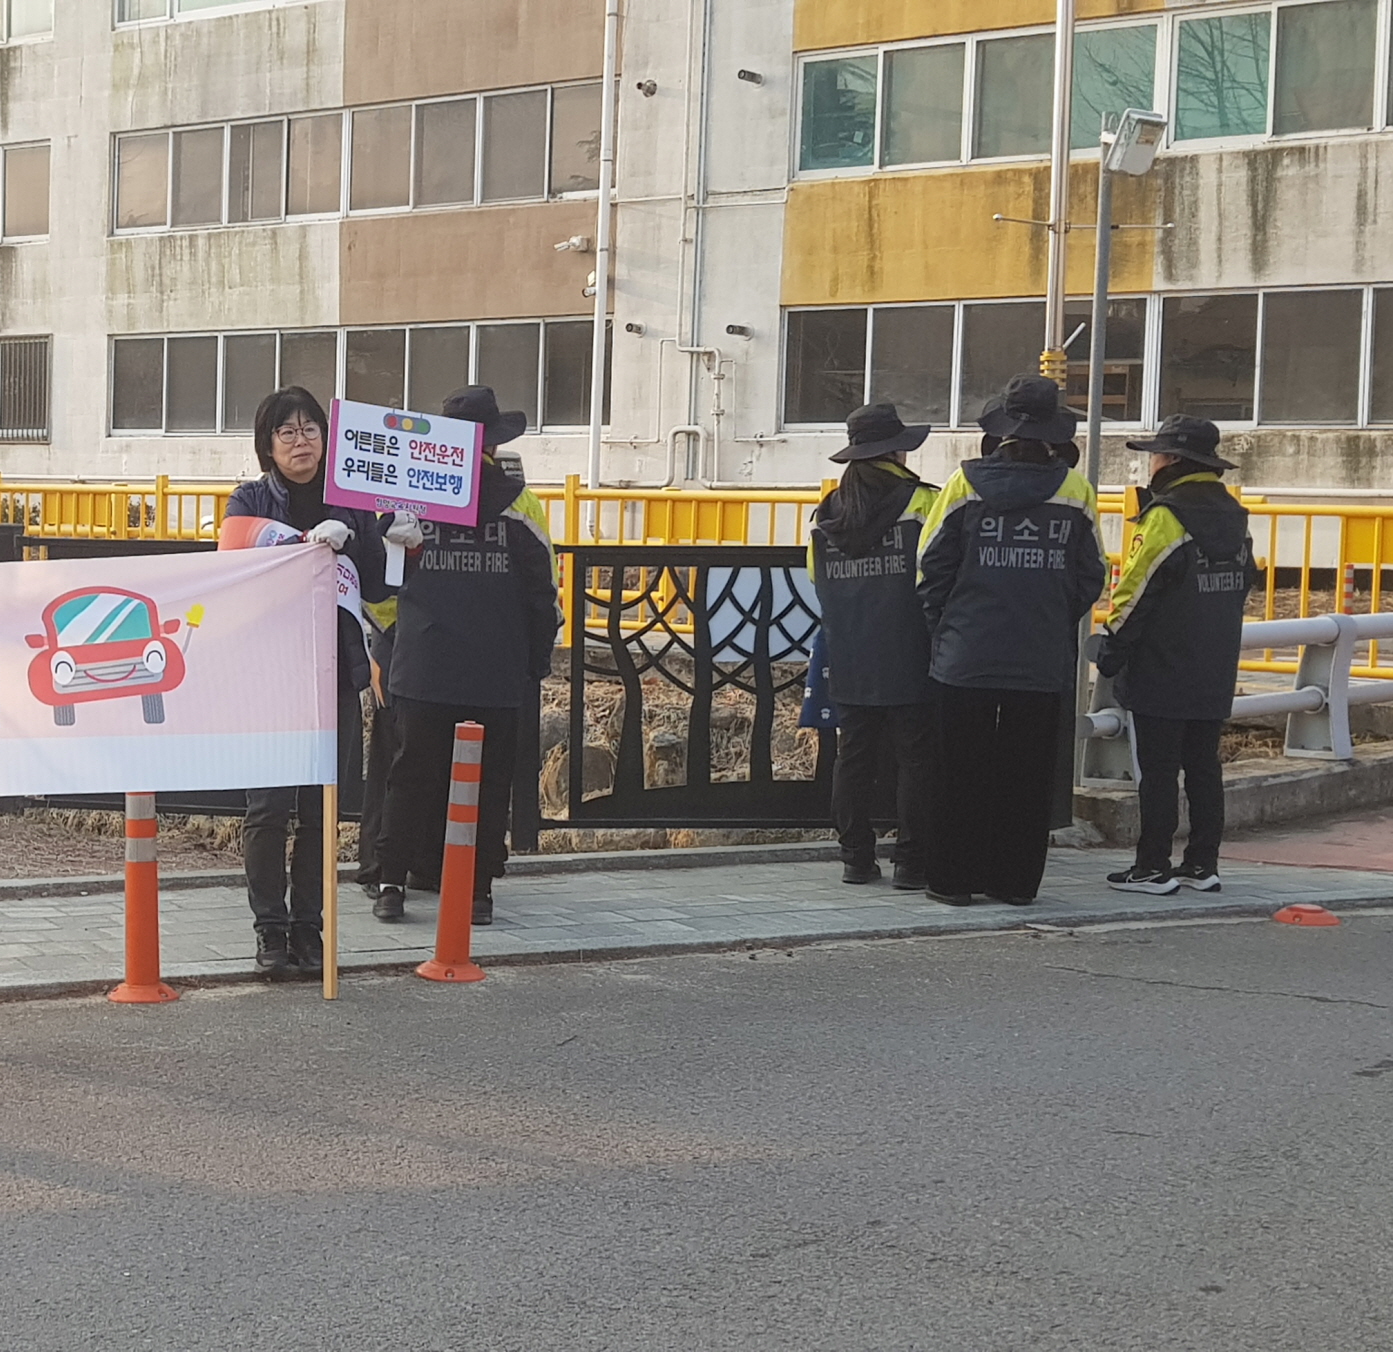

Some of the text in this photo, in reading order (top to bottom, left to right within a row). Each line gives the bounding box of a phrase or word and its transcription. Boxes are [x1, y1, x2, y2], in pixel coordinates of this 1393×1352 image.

[344, 429, 464, 467] 어른들은 안전운전
[342, 457, 462, 495] 우리들은 안전보행
[486, 553, 508, 573] FIRE
[826, 554, 906, 579] VOLUNTEER FIRE
[979, 546, 1044, 568] VOLUNTEER
